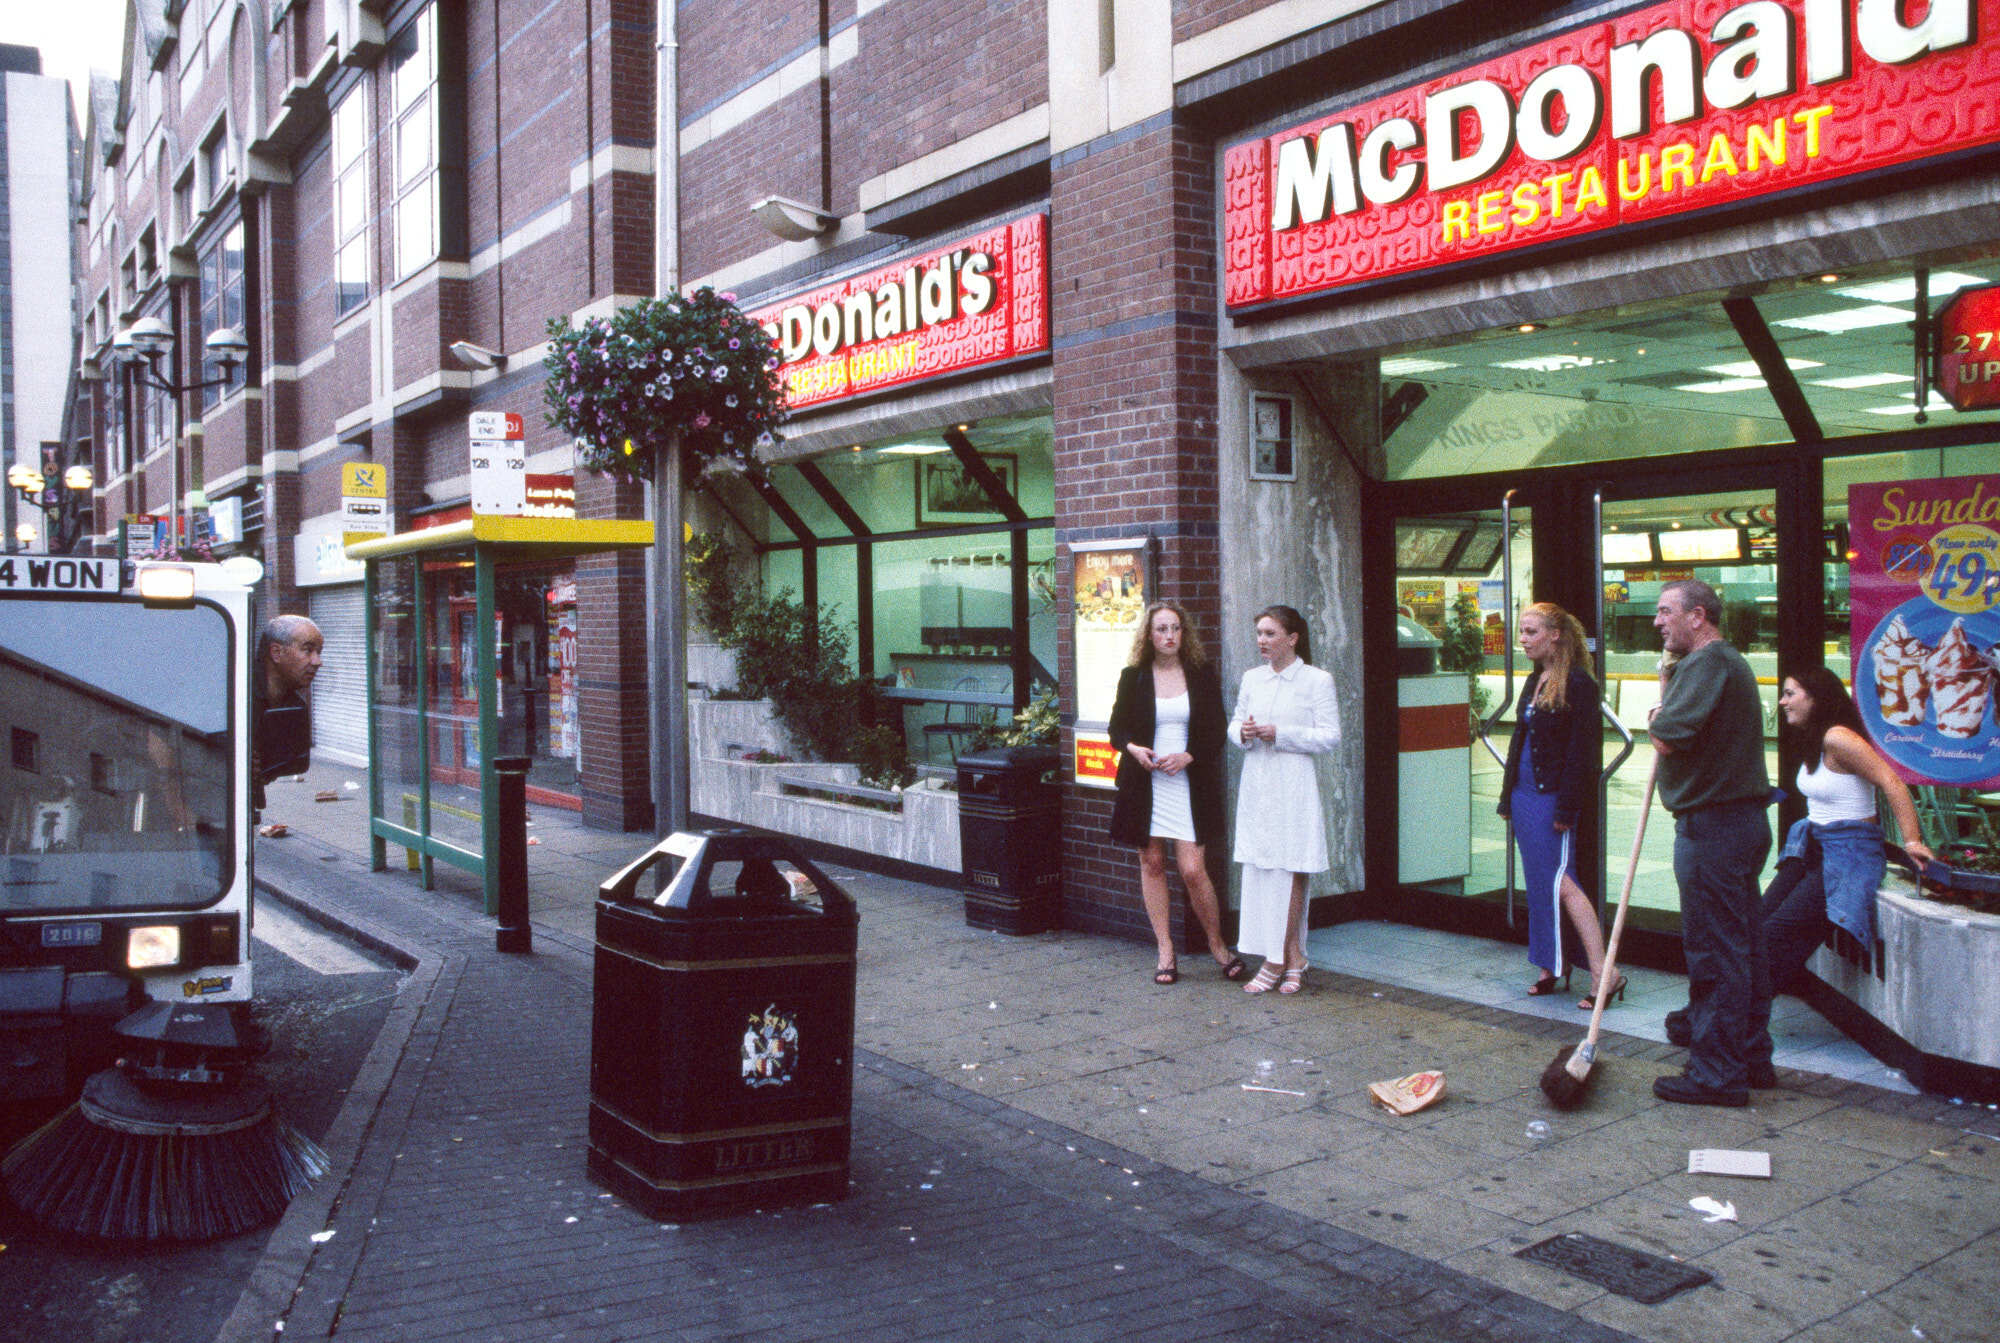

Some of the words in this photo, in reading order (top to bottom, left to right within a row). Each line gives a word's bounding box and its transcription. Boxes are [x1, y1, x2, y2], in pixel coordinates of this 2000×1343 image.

[1442, 105, 1833, 244] RESTAURANT
[764, 249, 996, 364] Donald's
[1953, 332, 2000, 354] 27
[790, 340, 919, 398] RESTAURANT
[1437, 417, 1525, 450] KINGS
[472, 458, 489, 469] 128
[506, 458, 525, 470] 129
[1872, 481, 2000, 531] Sunda
[1886, 543, 1931, 575] 89p
[1968, 533, 1998, 552] only
[28, 559, 104, 589] WON
[1086, 553, 1109, 569] Enjoy
[1111, 553, 1134, 566] more
[1930, 551, 2000, 606] 49p
[715, 1136, 813, 1170] LITTER
